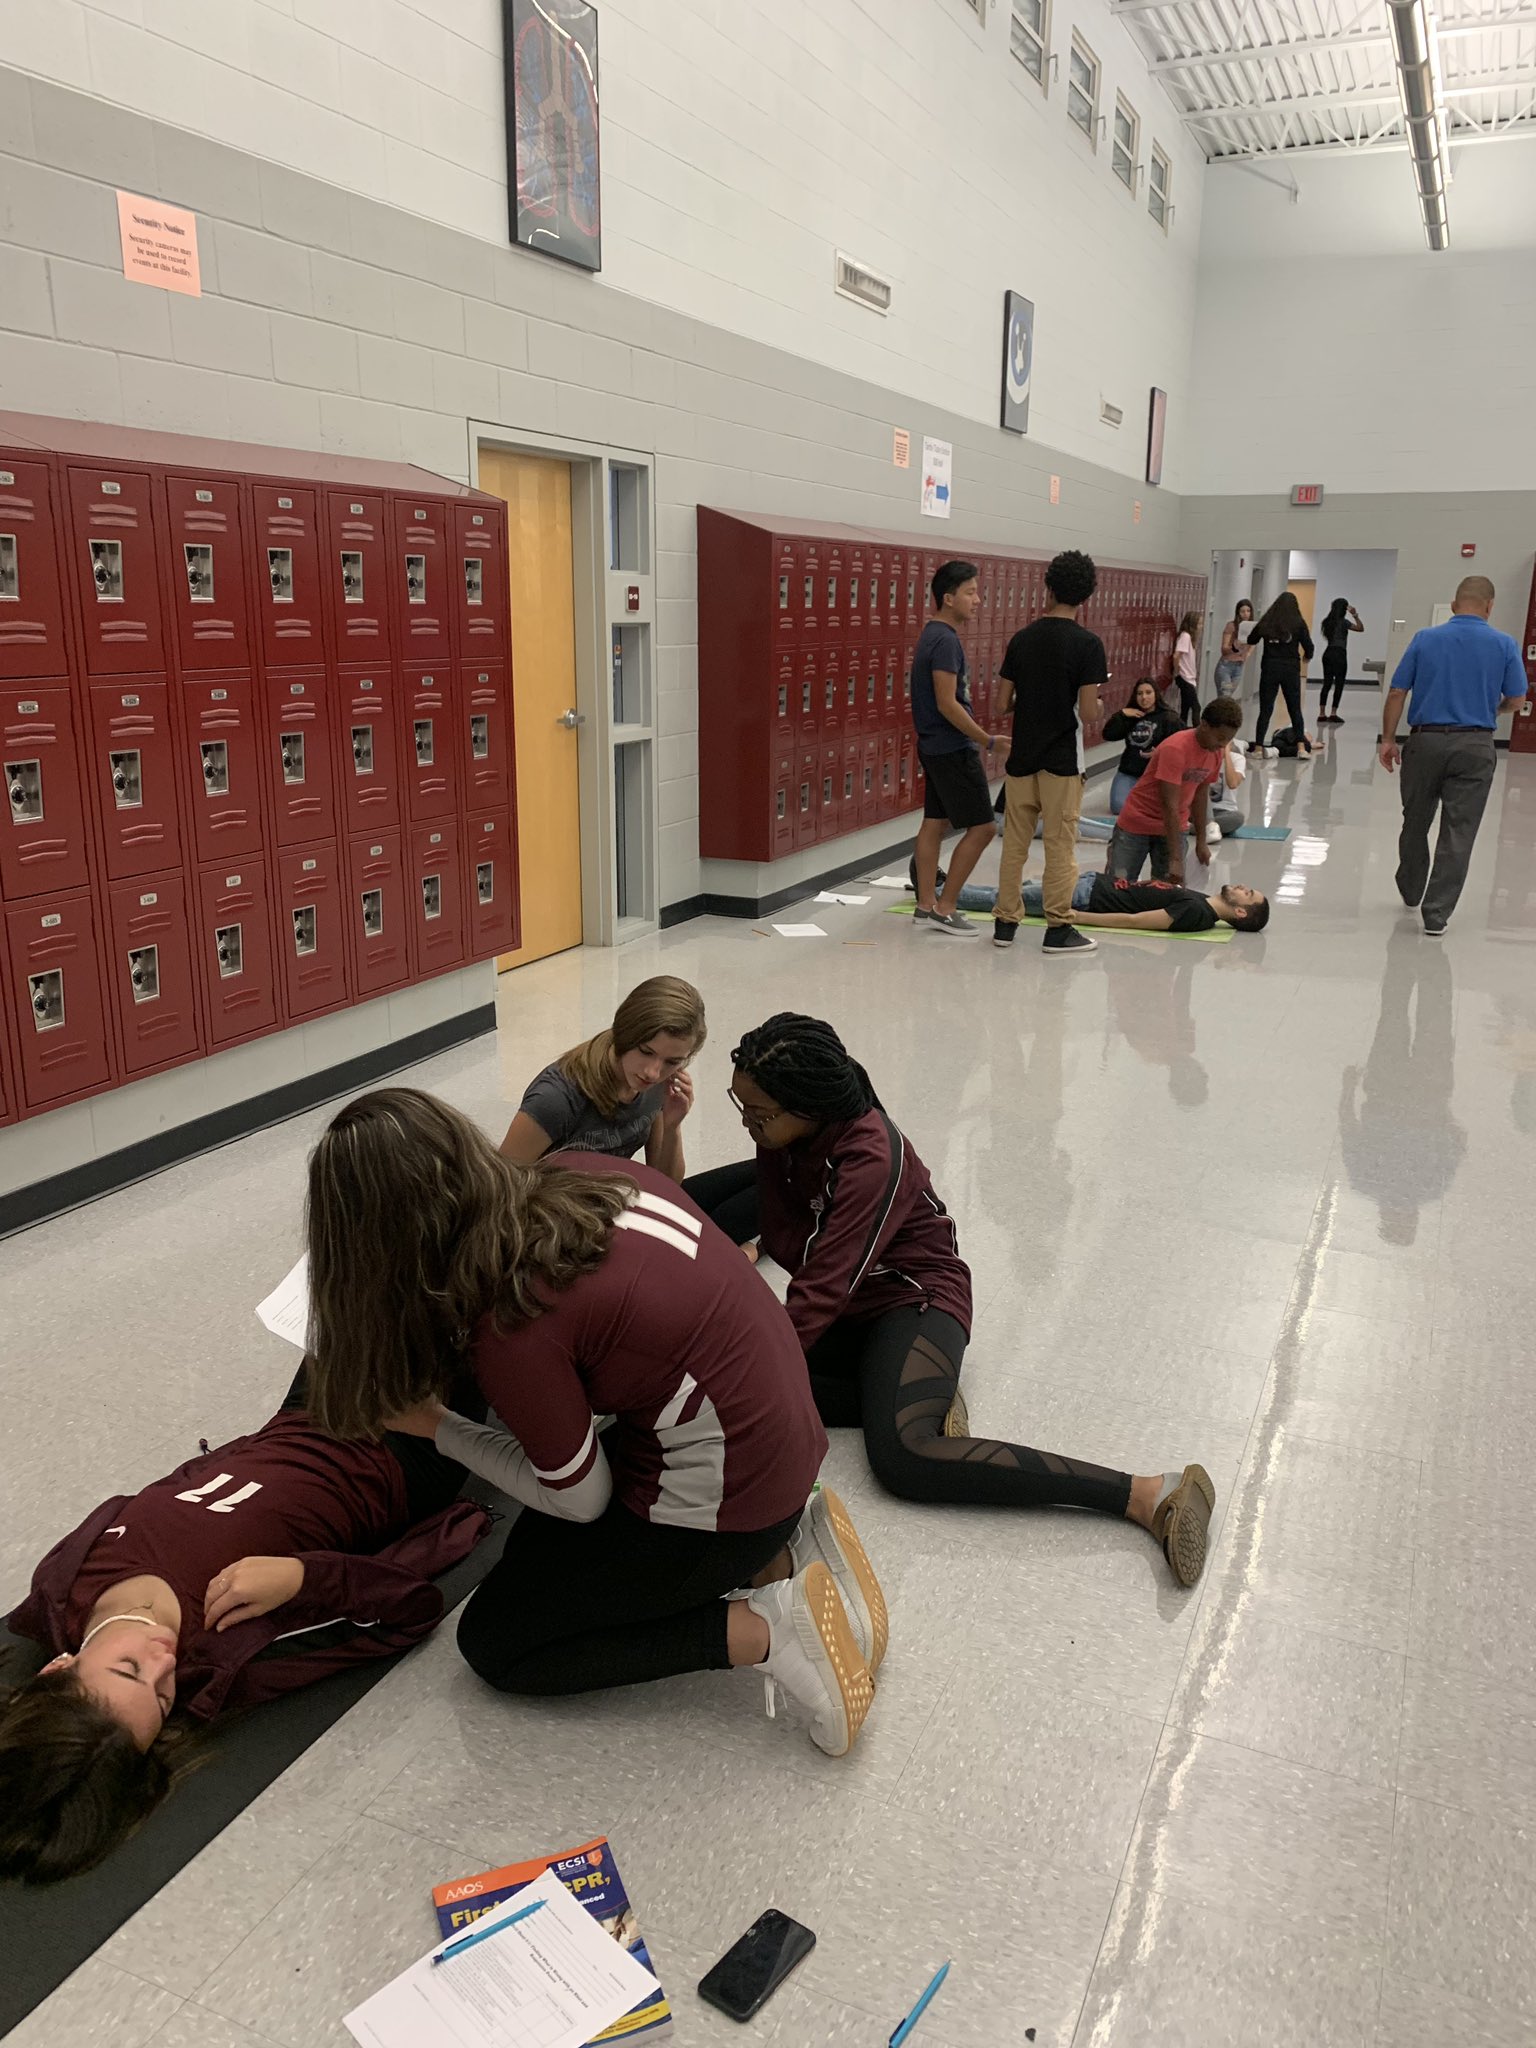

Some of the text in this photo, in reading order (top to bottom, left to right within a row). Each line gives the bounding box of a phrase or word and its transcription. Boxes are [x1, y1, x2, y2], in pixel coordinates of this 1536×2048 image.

[132, 213, 185, 236] Security Notice
[128, 233, 192, 258] Security cameras may
[137, 246, 145, 255] be
[145, 250, 160, 259] used
[168, 256, 187, 266] record
[132, 257, 152, 268] events
[160, 263, 171, 273] this
[1297, 486, 1319, 503] EXIT
[612, 1186, 704, 1261] 11
[174, 1472, 264, 1513] 11
[557, 1855, 586, 1871] ECSI
[445, 1880, 484, 1901] AAOS
